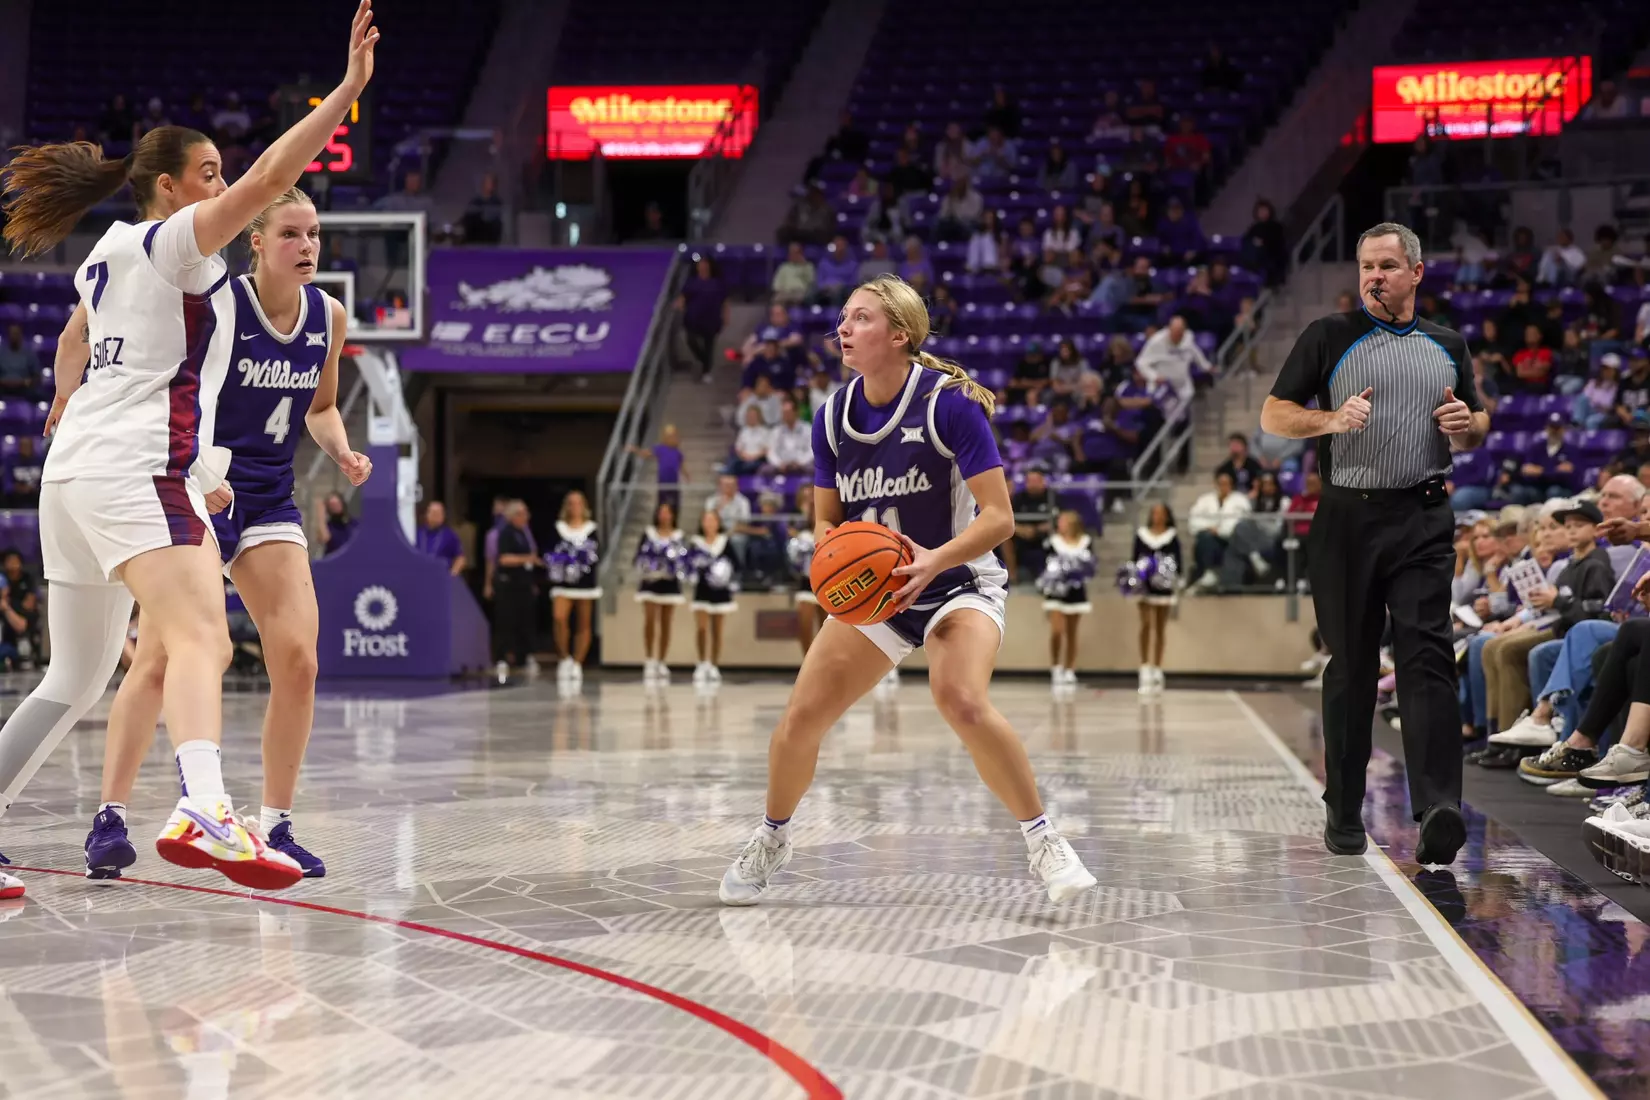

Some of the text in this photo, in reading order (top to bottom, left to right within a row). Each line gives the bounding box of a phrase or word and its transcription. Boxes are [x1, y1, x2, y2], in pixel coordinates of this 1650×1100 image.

[85, 260, 110, 310] 7
[482, 320, 611, 345] EECU
[237, 357, 321, 389] Wildcats
[263, 395, 294, 444] 4
[835, 463, 933, 503] Wildcats
[826, 566, 879, 609] ELITE
[342, 627, 410, 658] Frost
